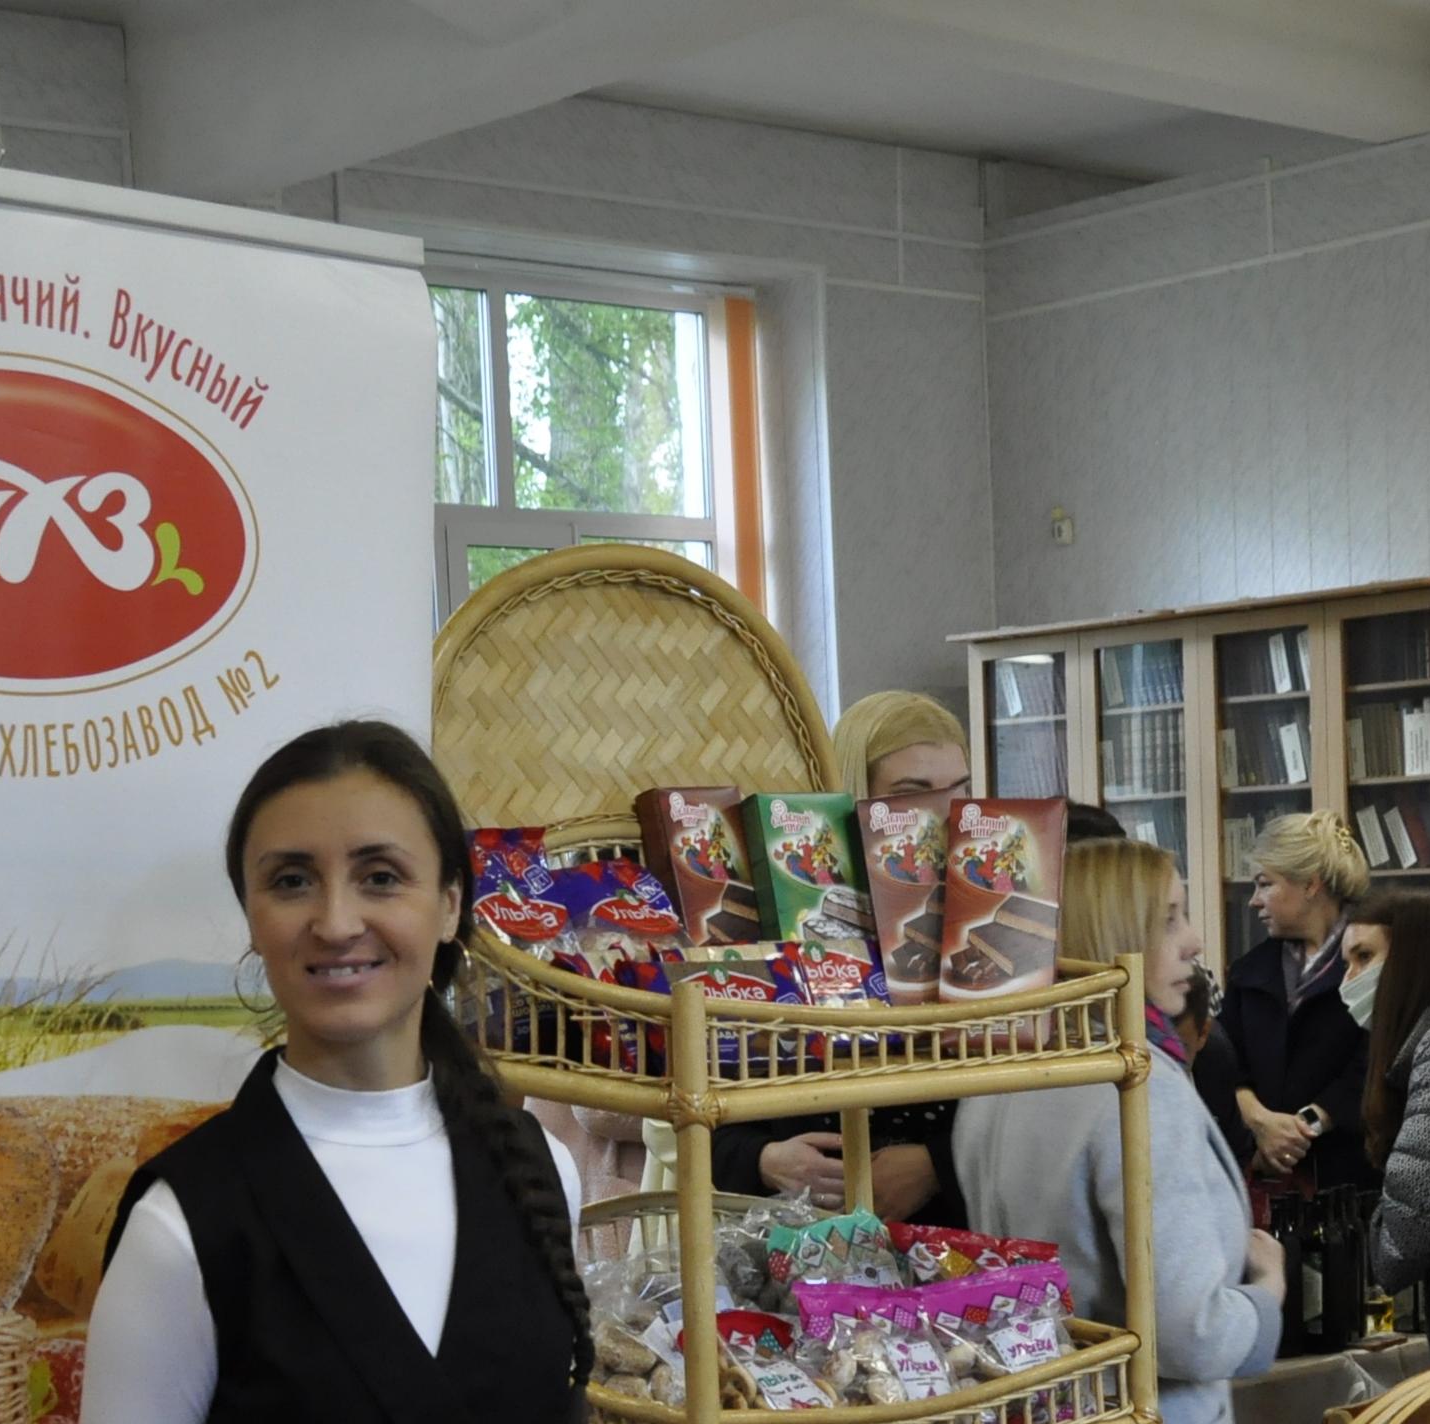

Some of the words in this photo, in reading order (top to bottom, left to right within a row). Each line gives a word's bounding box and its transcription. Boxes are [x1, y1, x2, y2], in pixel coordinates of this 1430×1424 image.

[108, 288, 271, 430] Вкусный
[806, 956, 861, 979] ыбка
[703, 980, 767, 1001] лыбка
